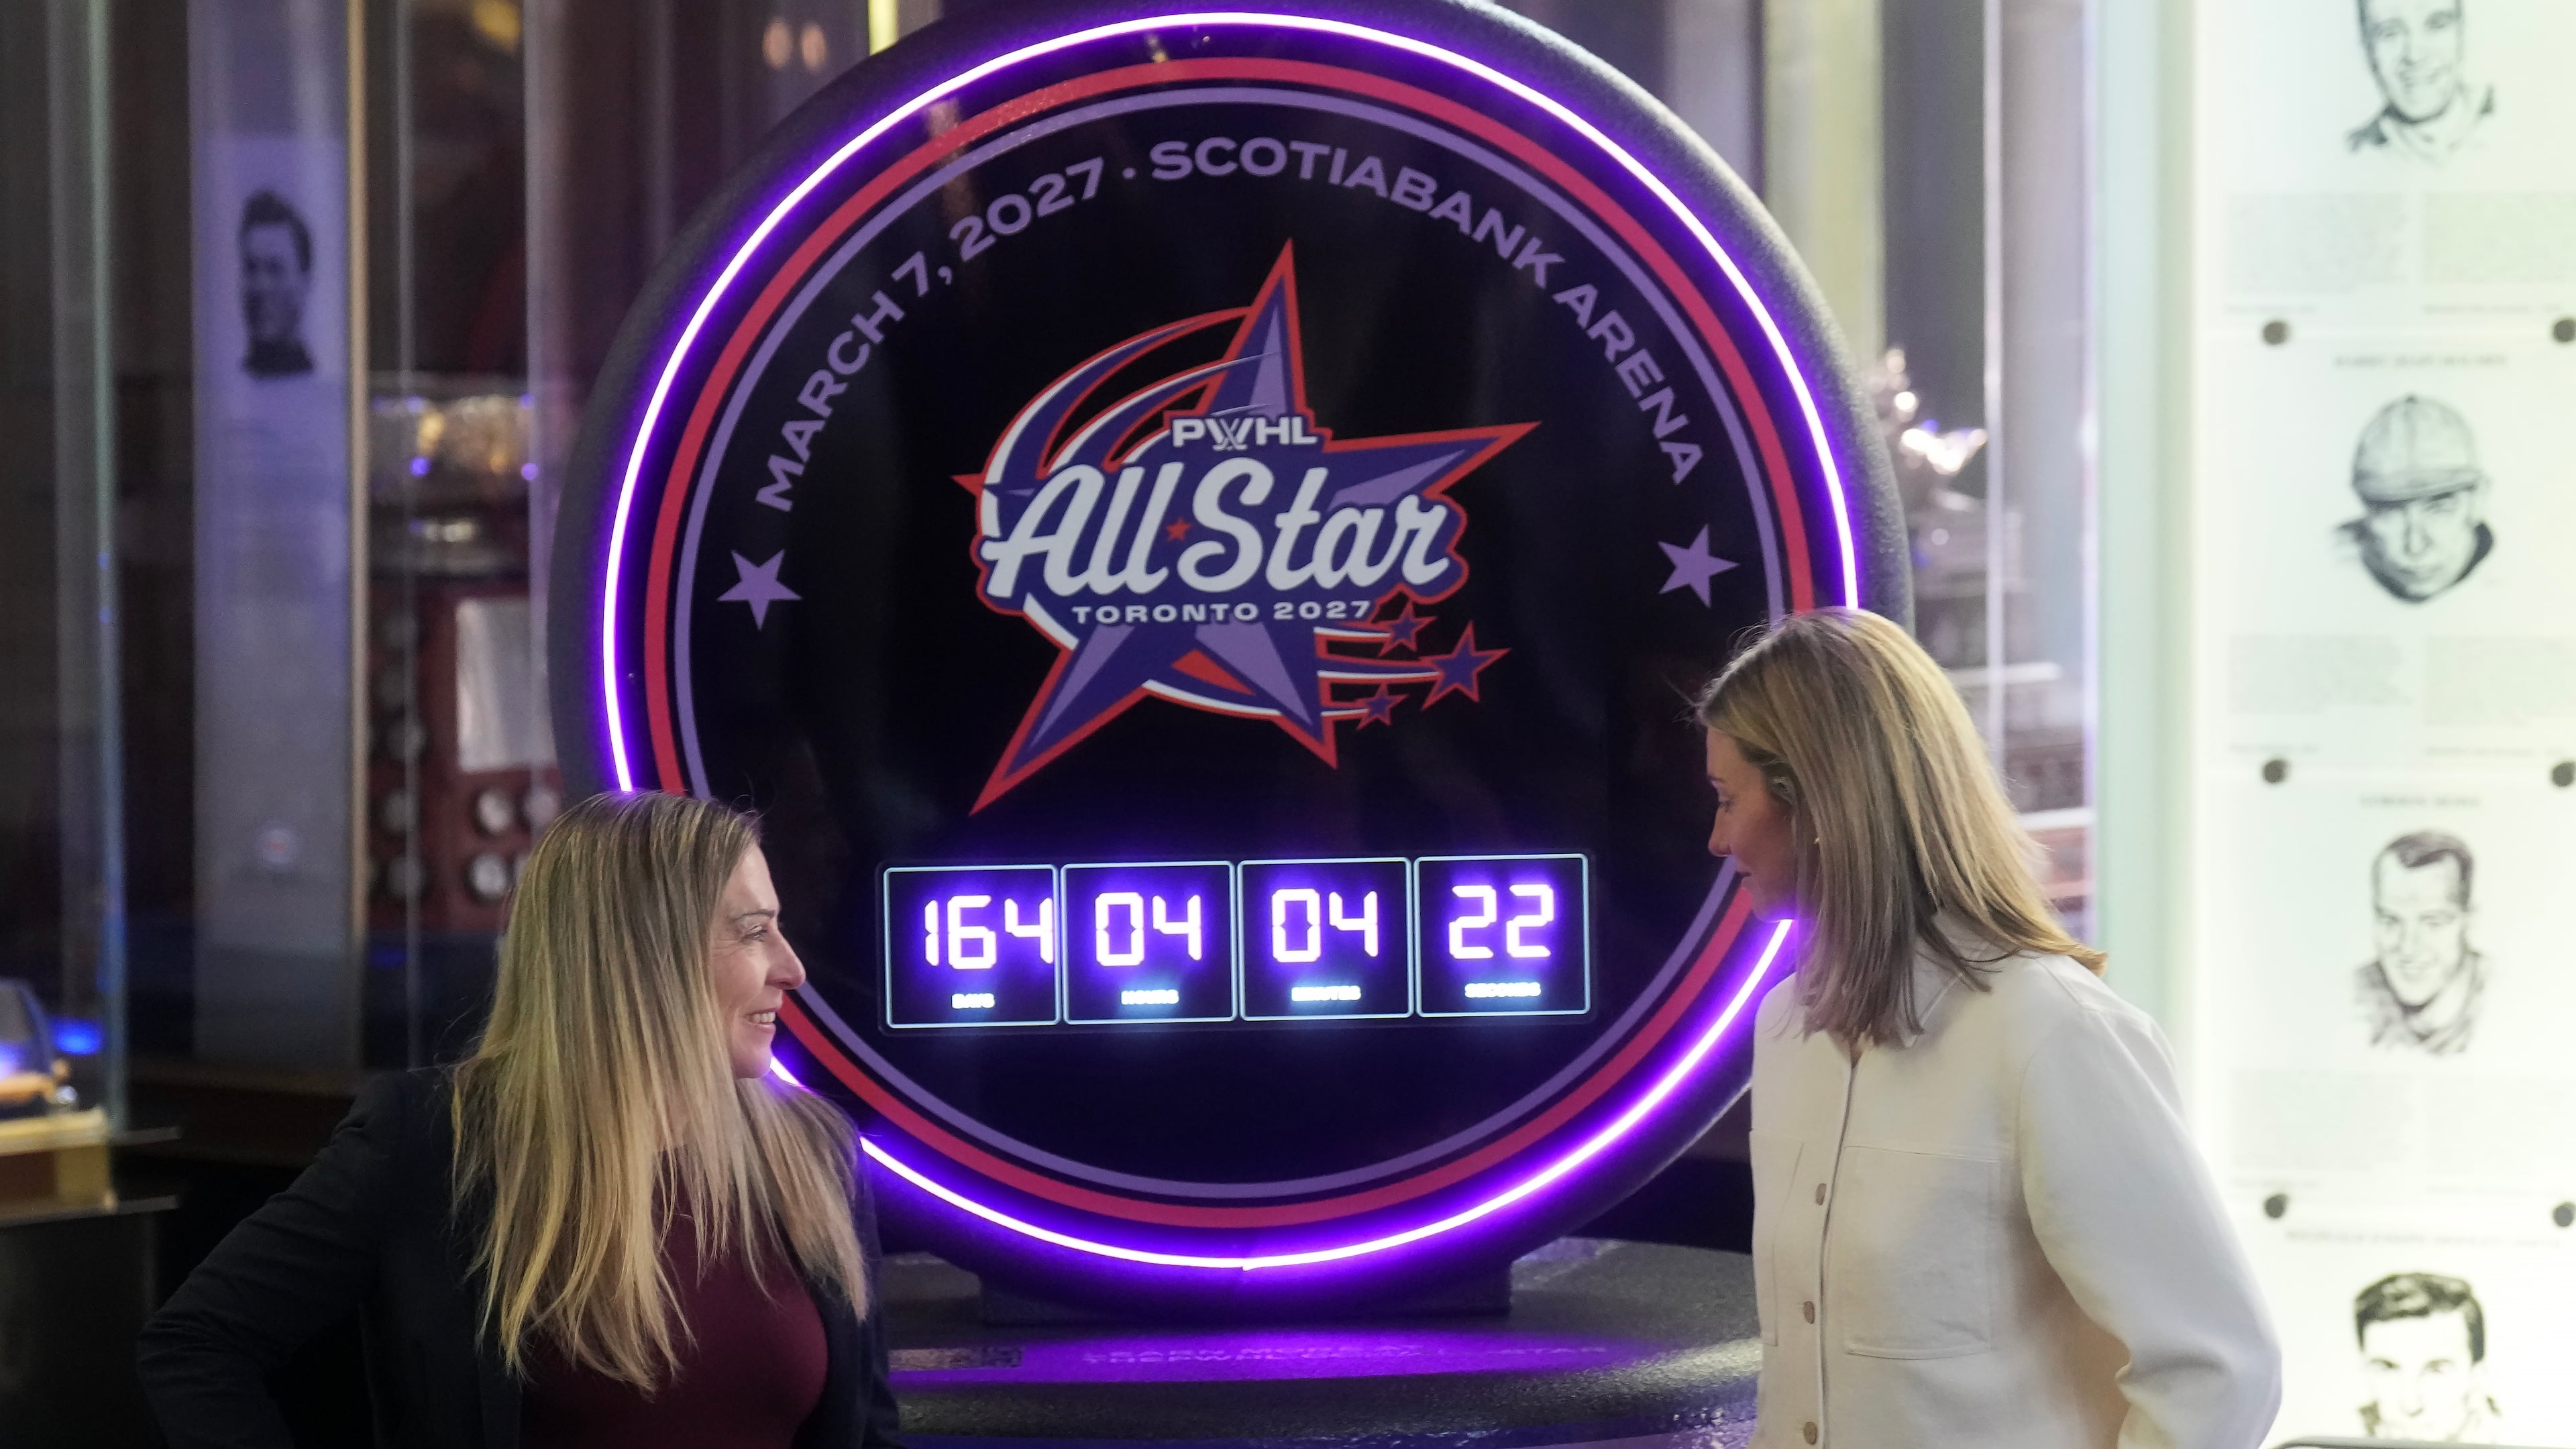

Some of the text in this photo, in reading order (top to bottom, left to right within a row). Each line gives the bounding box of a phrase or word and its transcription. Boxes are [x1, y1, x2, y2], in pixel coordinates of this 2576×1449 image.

[755, 136, 1705, 513] MARCH 7, 2027 SCOTIABANK ARENA
[1172, 416, 1318, 450] PWHL
[981, 456, 1450, 598] All Star
[1073, 598, 1372, 625] TORONTO 2027
[924, 883, 1555, 970] 164 04 04 22
